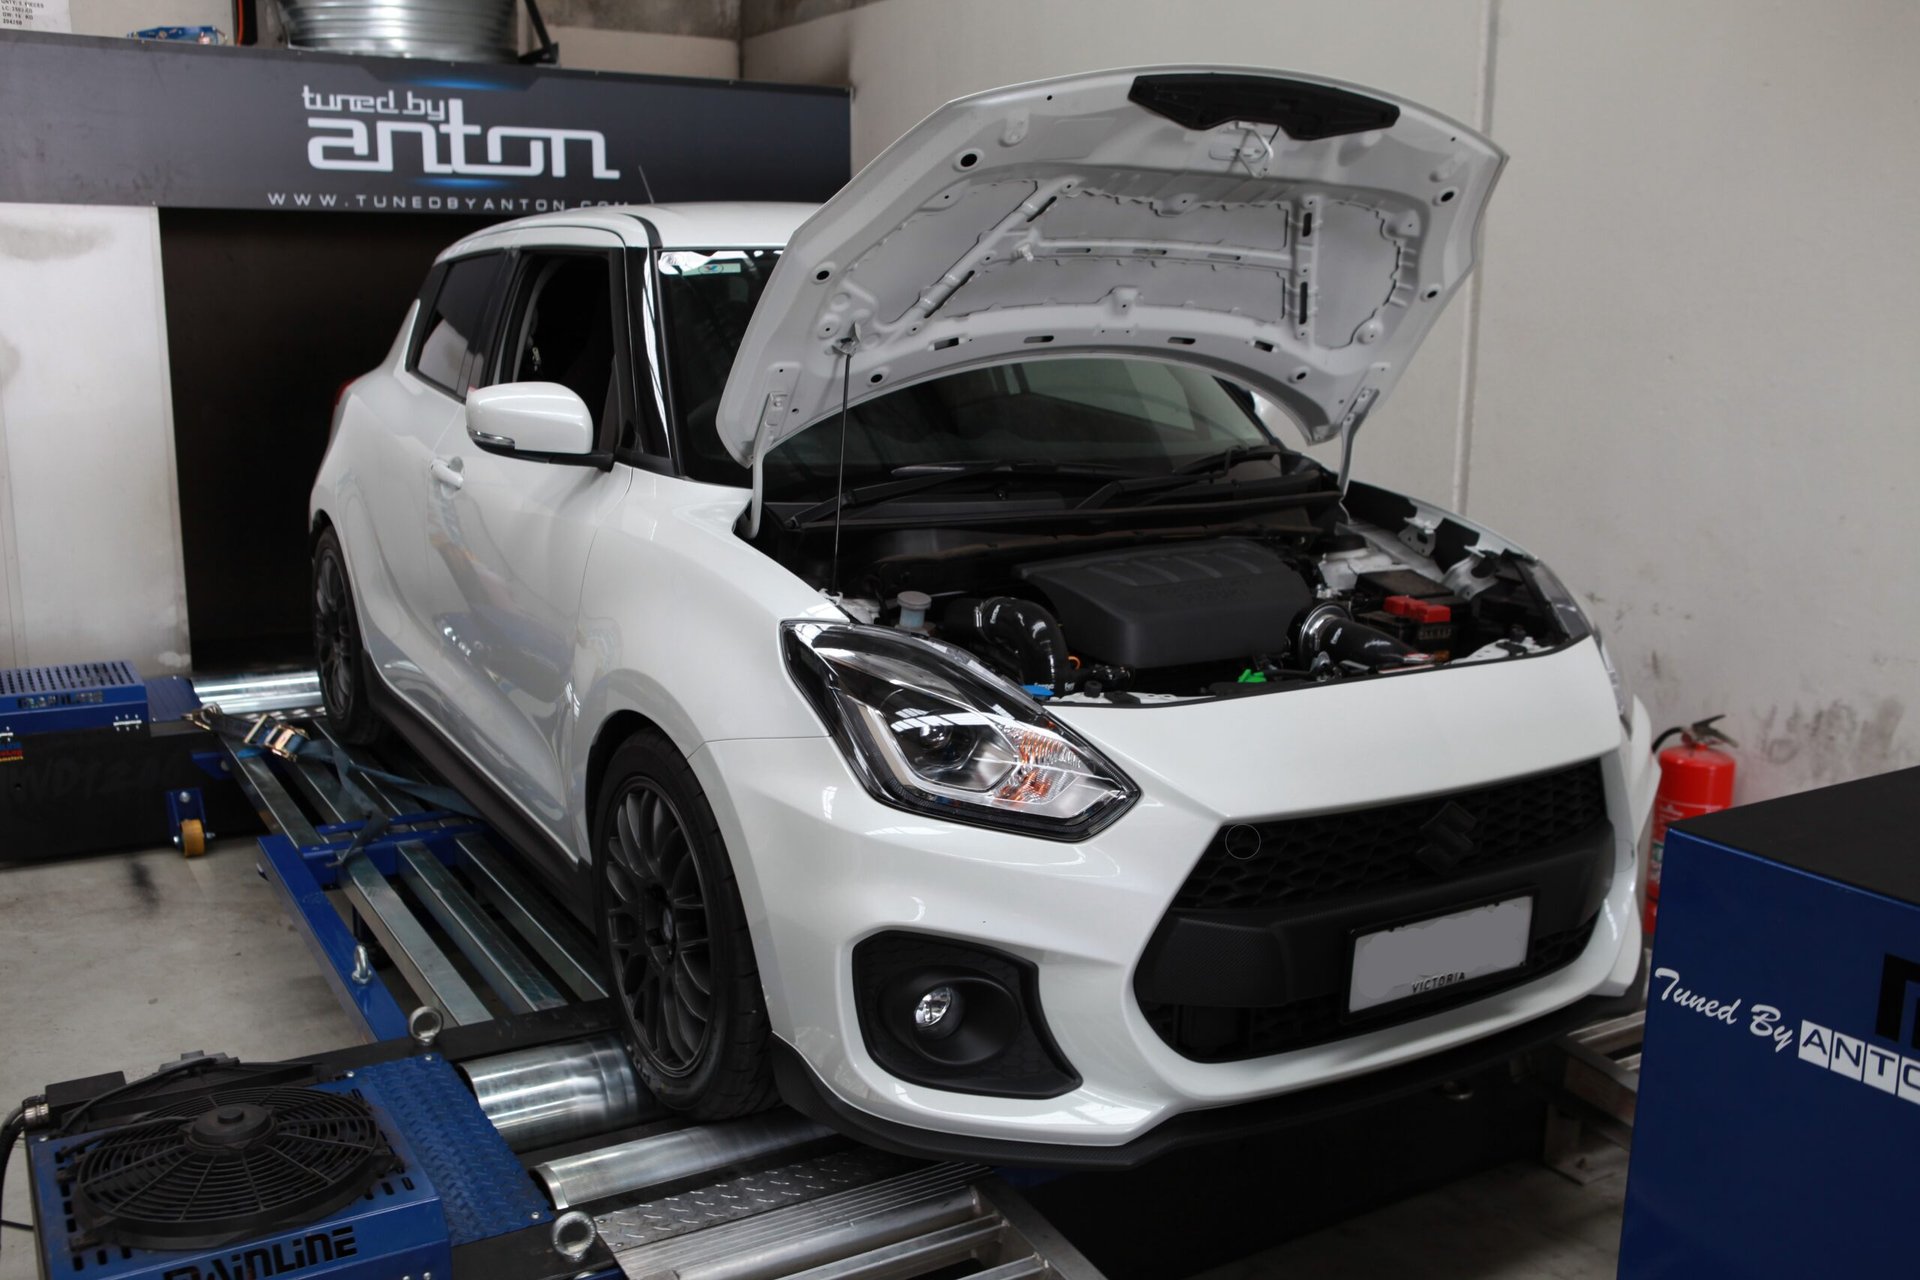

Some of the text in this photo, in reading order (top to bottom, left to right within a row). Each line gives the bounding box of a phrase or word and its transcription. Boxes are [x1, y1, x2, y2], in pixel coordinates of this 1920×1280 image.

[302, 85, 446, 121] tuned by
[307, 98, 621, 180] anton
[267, 192, 629, 212] WWW.TUNEDBYANTONCO
[1411, 972, 1466, 993] VICTORIA
[1655, 967, 1742, 1025] Tuned
[1750, 1003, 1794, 1053] By
